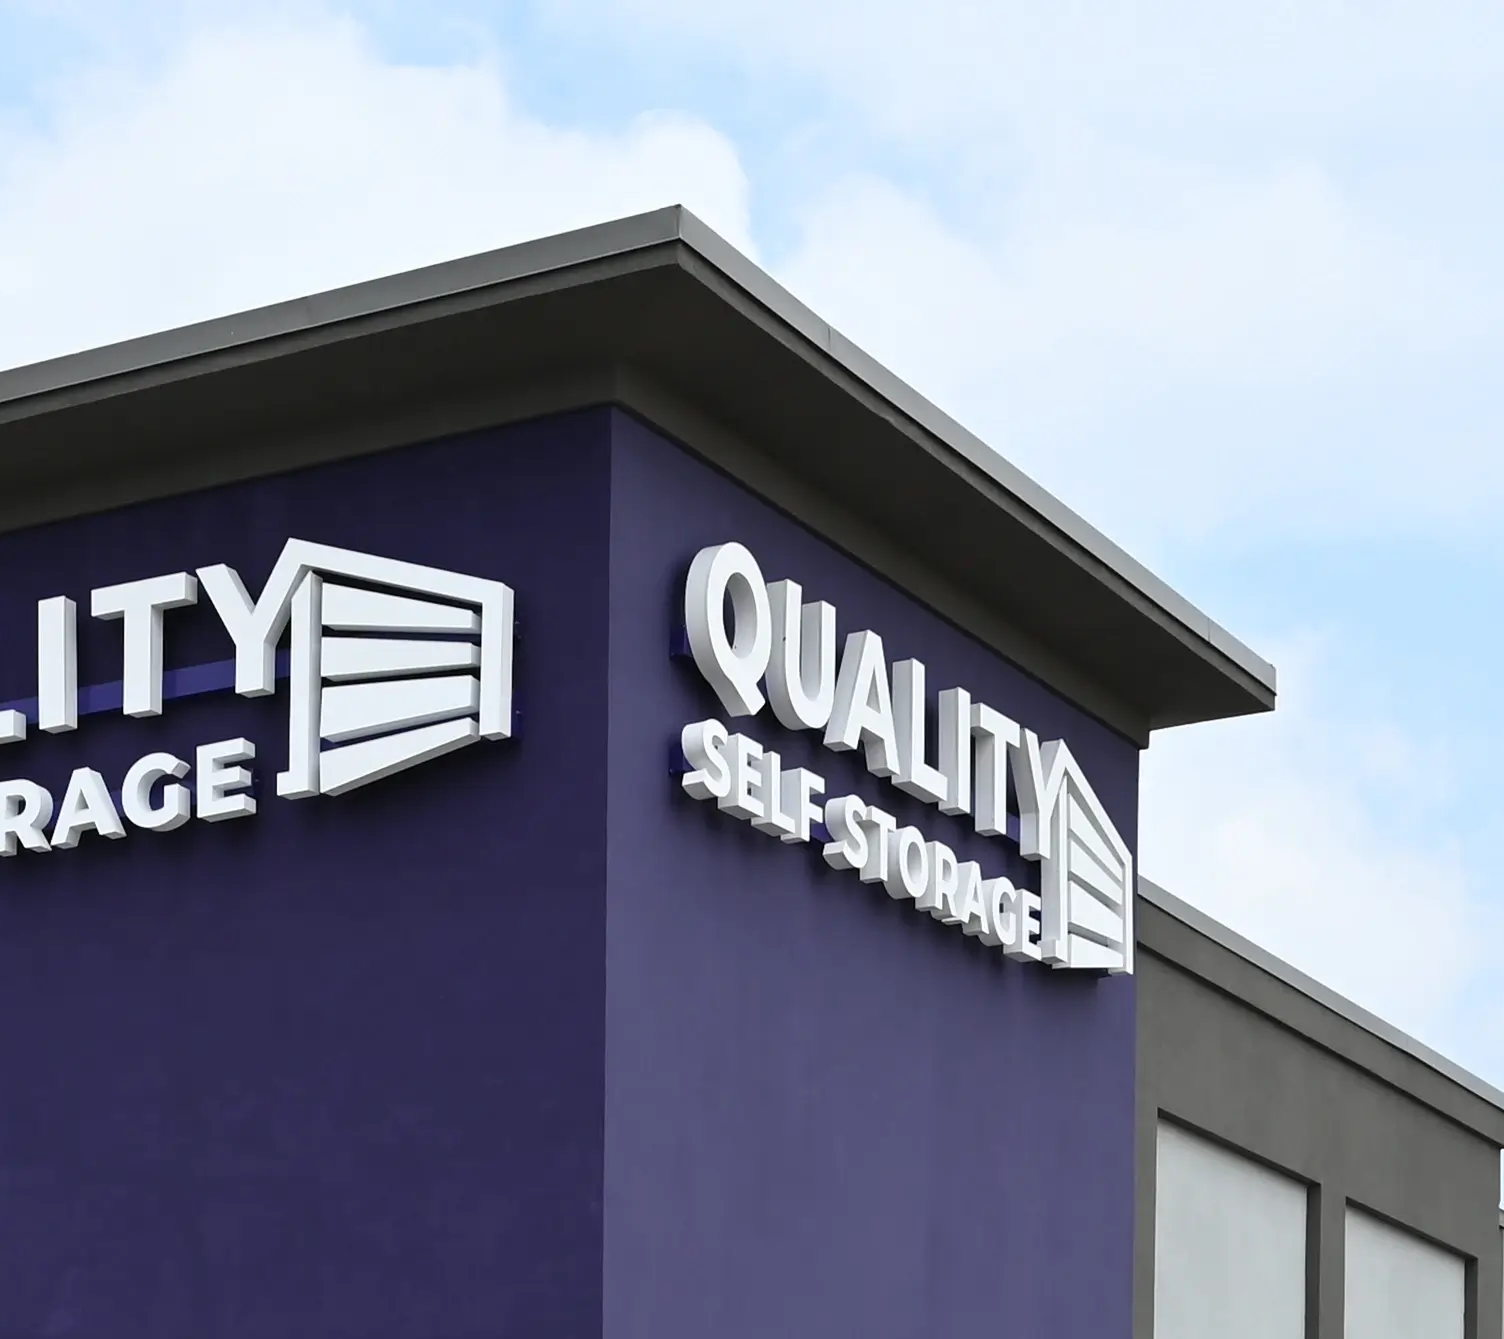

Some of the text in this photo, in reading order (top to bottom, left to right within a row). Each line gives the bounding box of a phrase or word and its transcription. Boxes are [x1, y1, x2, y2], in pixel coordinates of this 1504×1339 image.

[682, 718, 1043, 962] SELF STORAGE
[685, 541, 1062, 861] QUALITY
